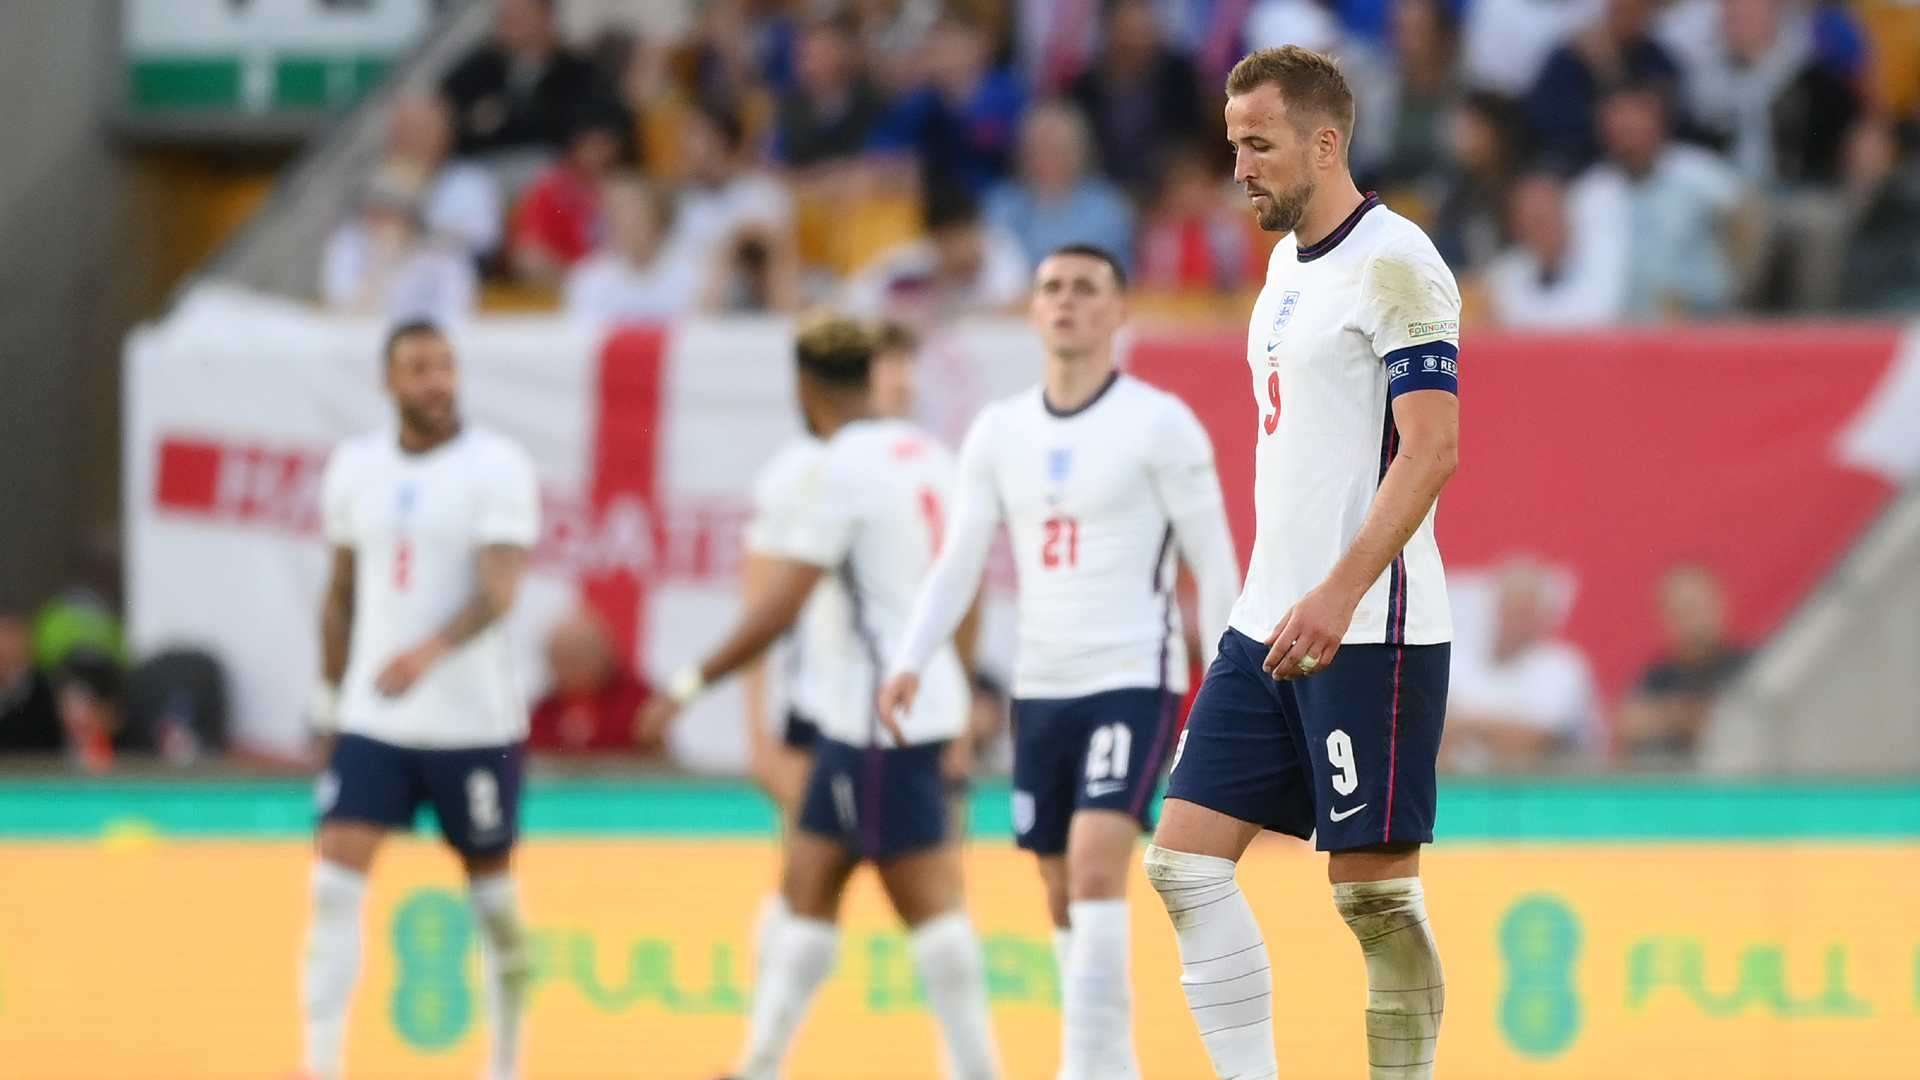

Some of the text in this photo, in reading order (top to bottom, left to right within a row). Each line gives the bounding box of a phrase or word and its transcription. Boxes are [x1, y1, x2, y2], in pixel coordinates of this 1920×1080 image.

[1388, 361, 1410, 377] ECT
[1264, 371, 1281, 435] 9
[1042, 519, 1079, 569] 21
[1086, 722, 1132, 781] 21
[1326, 729, 1358, 796] 9
